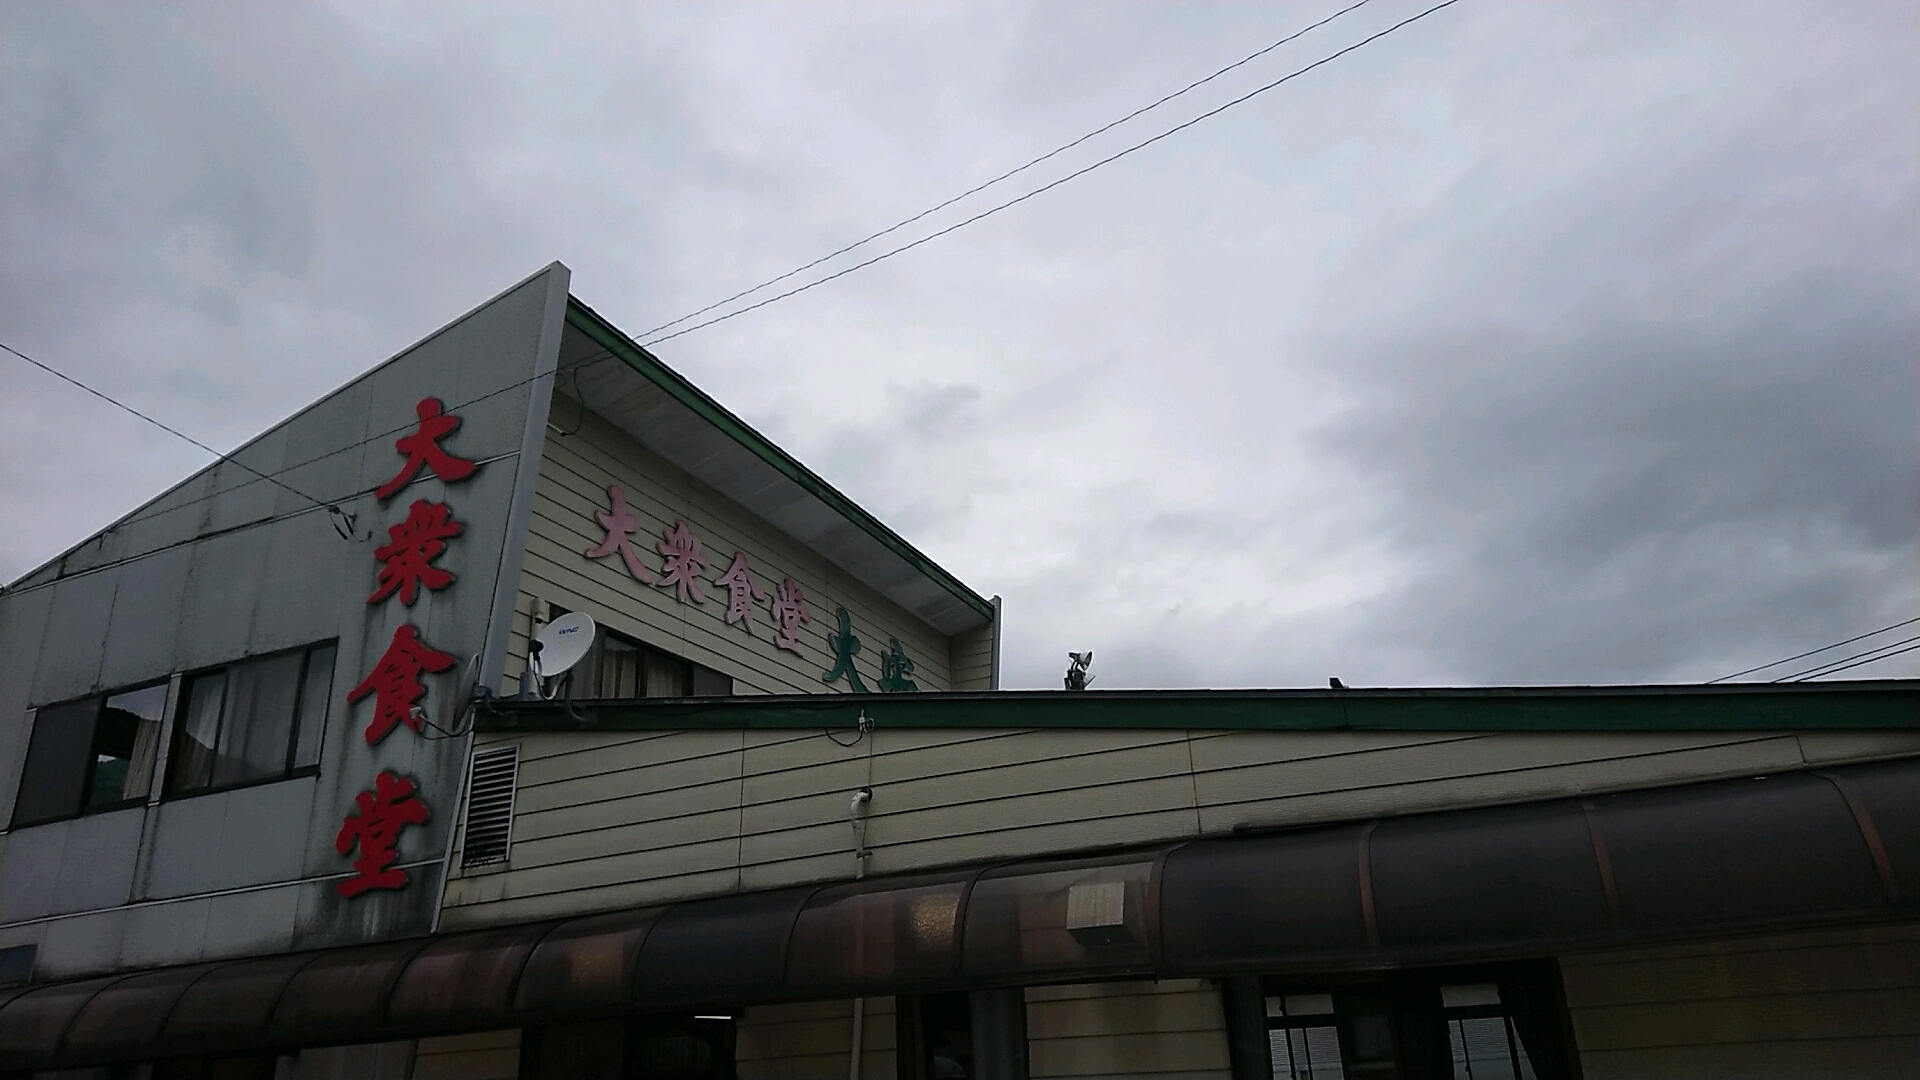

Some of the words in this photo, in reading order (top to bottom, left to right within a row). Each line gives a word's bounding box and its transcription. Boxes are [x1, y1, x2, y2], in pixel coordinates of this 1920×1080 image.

[335, 397, 477, 899] 大衆食堂
[584, 485, 810, 658] 大衆食堂
